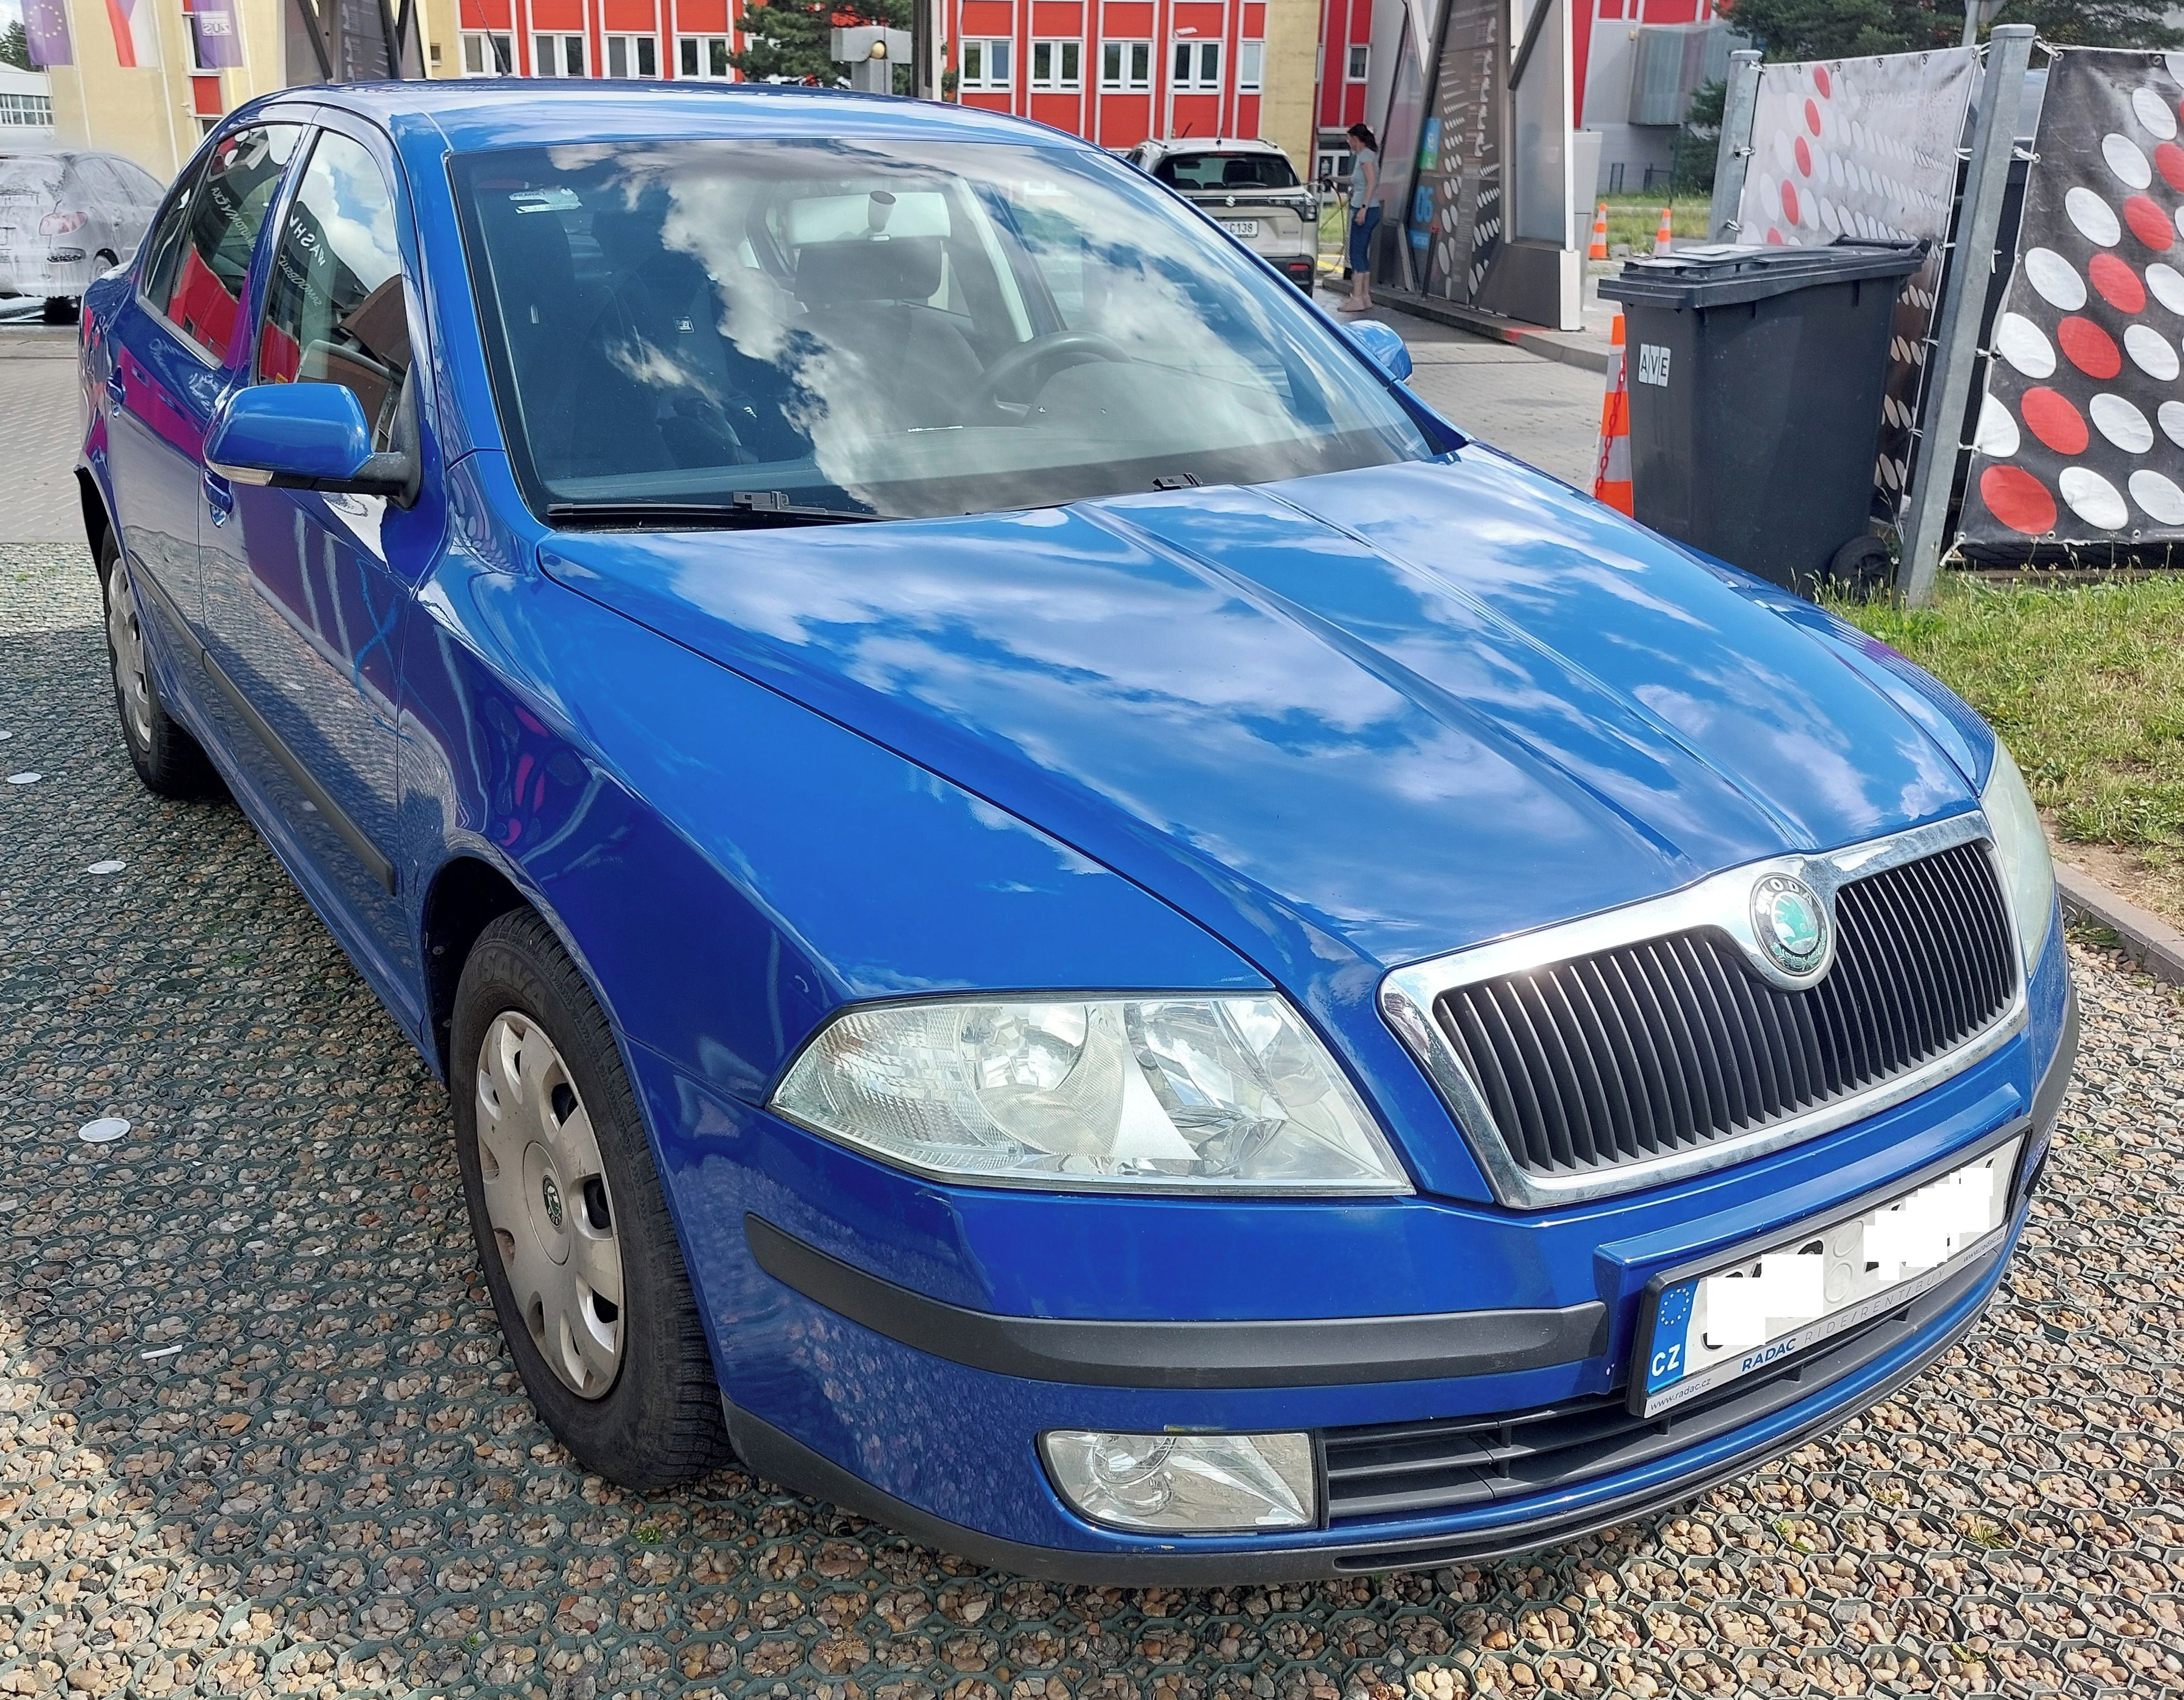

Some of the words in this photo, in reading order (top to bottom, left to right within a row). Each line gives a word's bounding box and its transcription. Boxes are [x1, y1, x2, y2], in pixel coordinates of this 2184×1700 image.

[1641, 353, 1668, 377] AVE
[1652, 1343, 1681, 1377] CZ
[1741, 1337, 1797, 1372] RADAC
[1651, 1378, 1711, 1410] www.radac.cz
